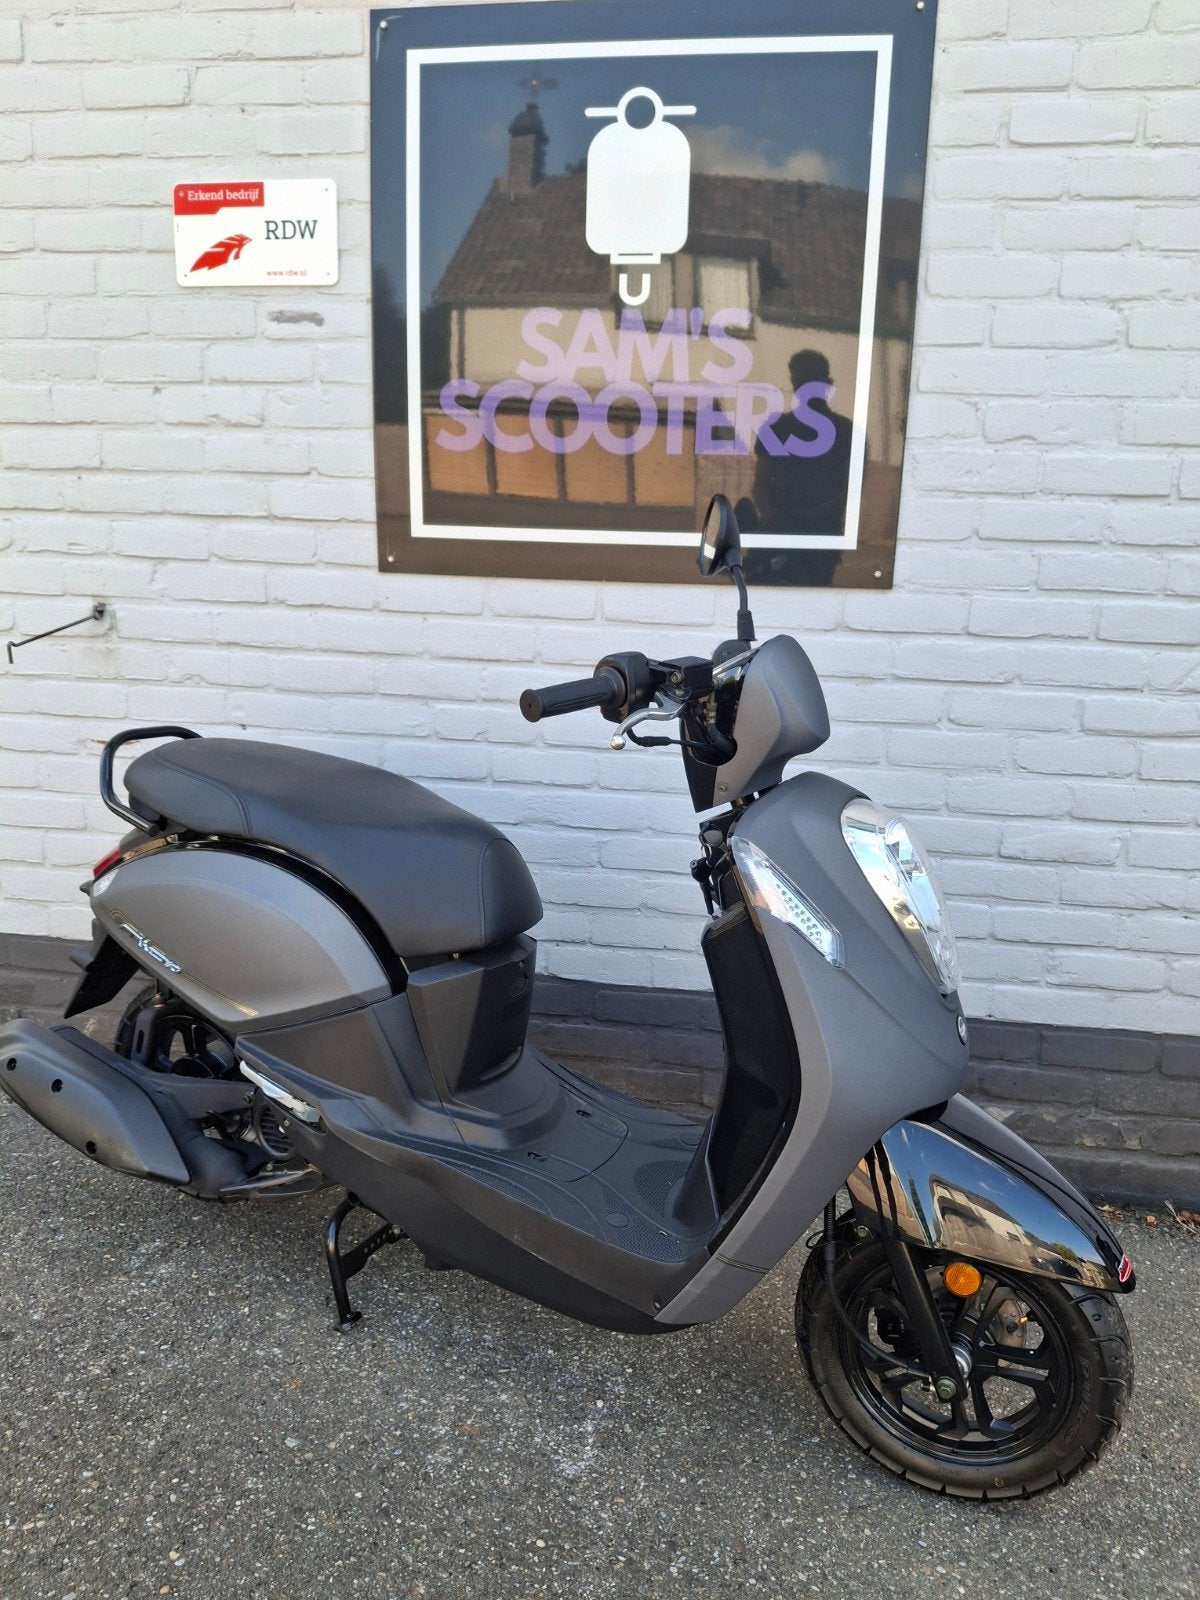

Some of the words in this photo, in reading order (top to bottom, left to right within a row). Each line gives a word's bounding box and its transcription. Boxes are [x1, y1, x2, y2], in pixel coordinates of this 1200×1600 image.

[187, 189, 224, 202] Erkend
[226, 188, 260, 203] bedrijf
[264, 219, 318, 240] RDW
[266, 268, 308, 277] www.rdw.nl
[515, 306, 755, 385] SAM'S
[435, 378, 837, 458] SCOOTERS
